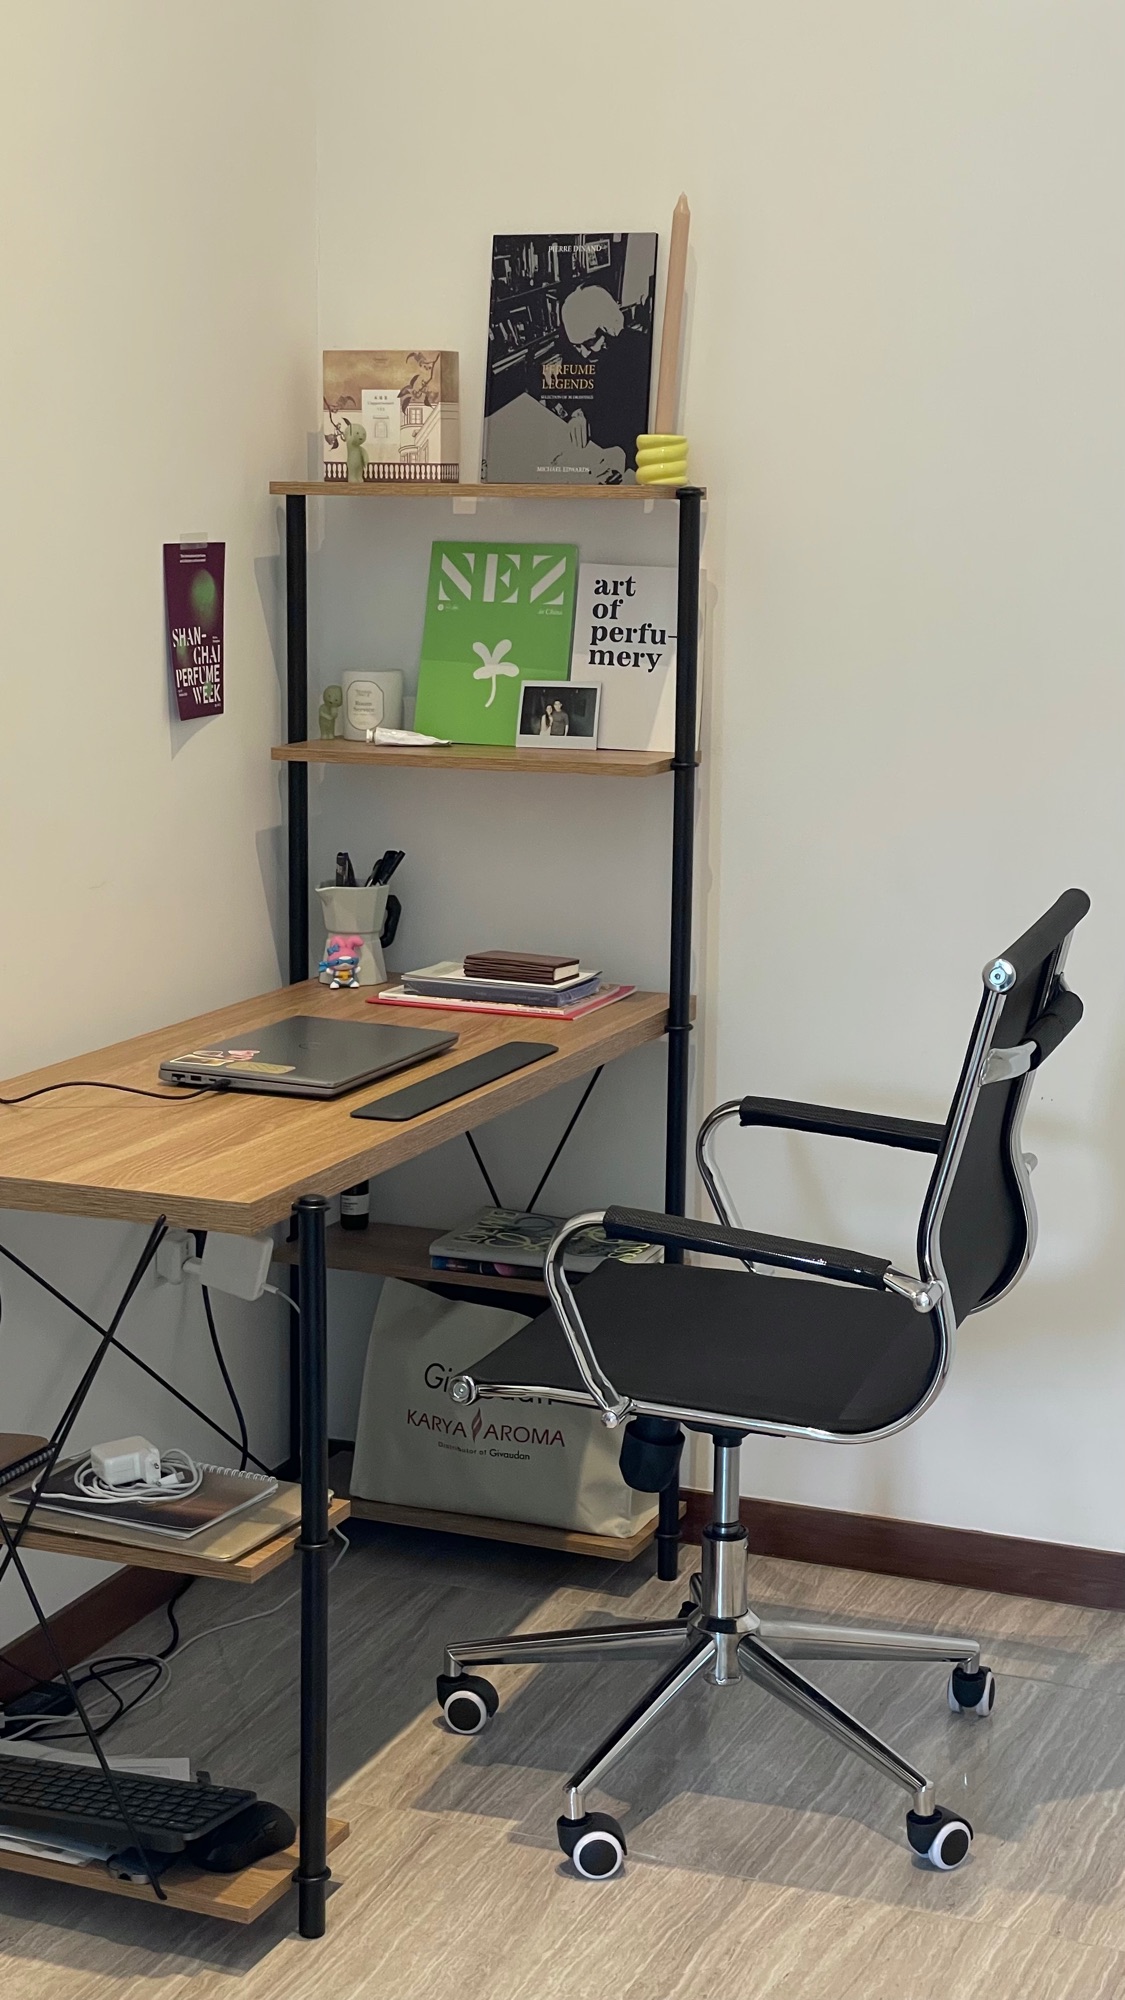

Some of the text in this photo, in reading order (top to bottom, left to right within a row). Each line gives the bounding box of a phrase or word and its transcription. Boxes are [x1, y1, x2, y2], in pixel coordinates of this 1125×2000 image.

[542, 364, 596, 375] PERFUME
[542, 379, 594, 389] LEGENDS
[438, 552, 567, 605] NEZ
[594, 575, 637, 597] art
[545, 608, 563, 616] China
[592, 598, 624, 620] of
[172, 626, 207, 648] SHAN-
[589, 623, 678, 646] perfu-
[193, 644, 221, 665] GHAI
[588, 649, 663, 673] mery
[175, 664, 221, 689] PERFUME
[192, 683, 221, 705] WEEK
[406, 1408, 566, 1448] KARYA AROMA
[489, 1448, 531, 1461] Givaudan
